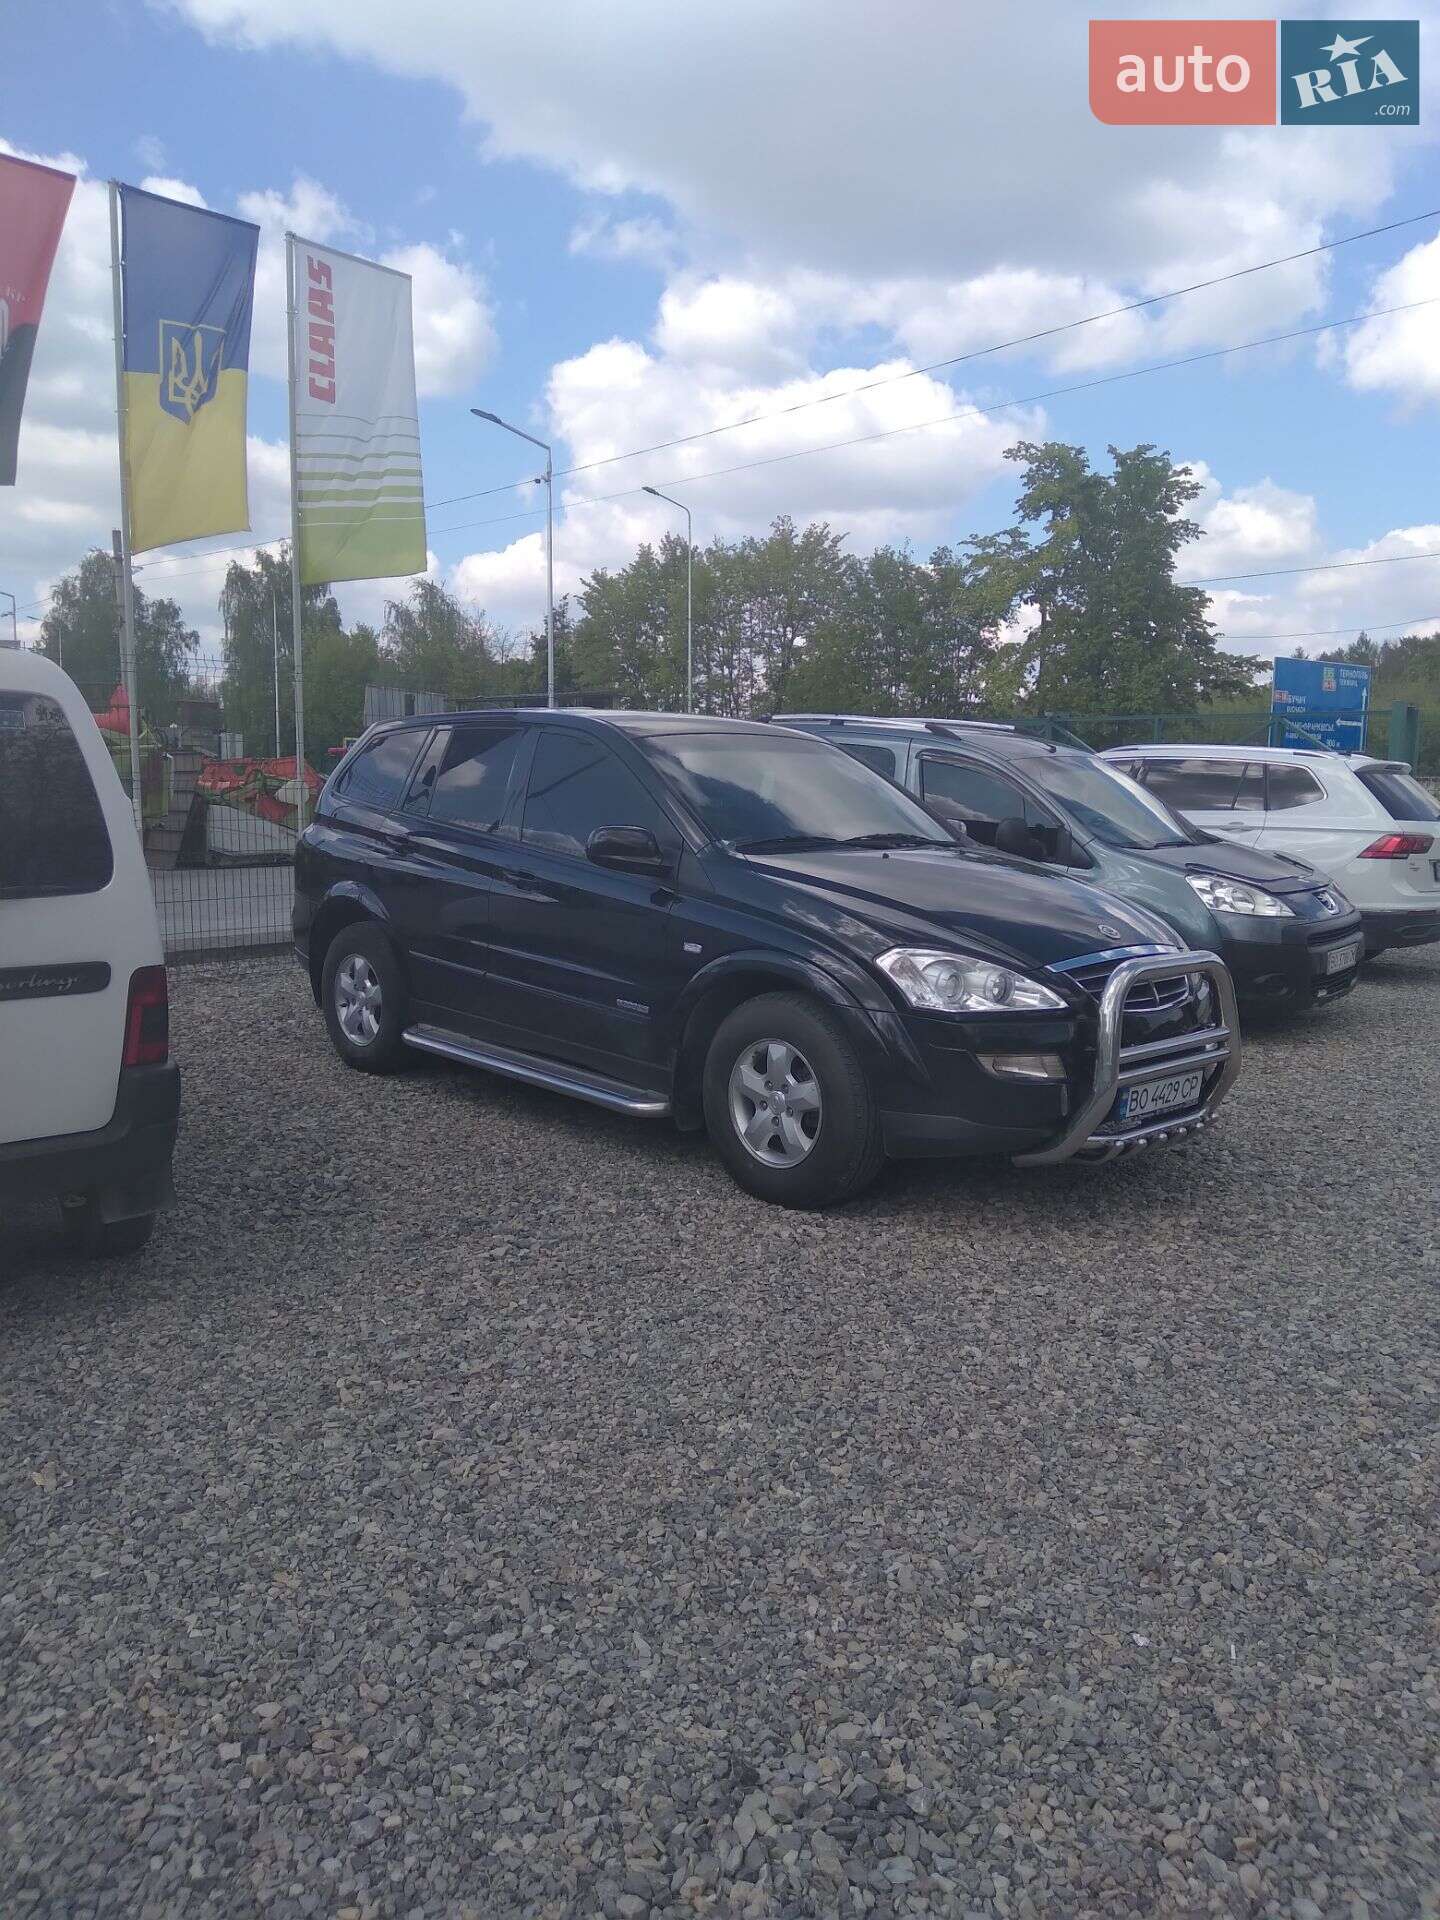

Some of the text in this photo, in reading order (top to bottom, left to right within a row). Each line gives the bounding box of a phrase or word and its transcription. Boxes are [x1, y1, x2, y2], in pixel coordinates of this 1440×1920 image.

[306, 254, 336, 405] CLAAS
[1128, 1075, 1199, 1113] BO 4429 CP
